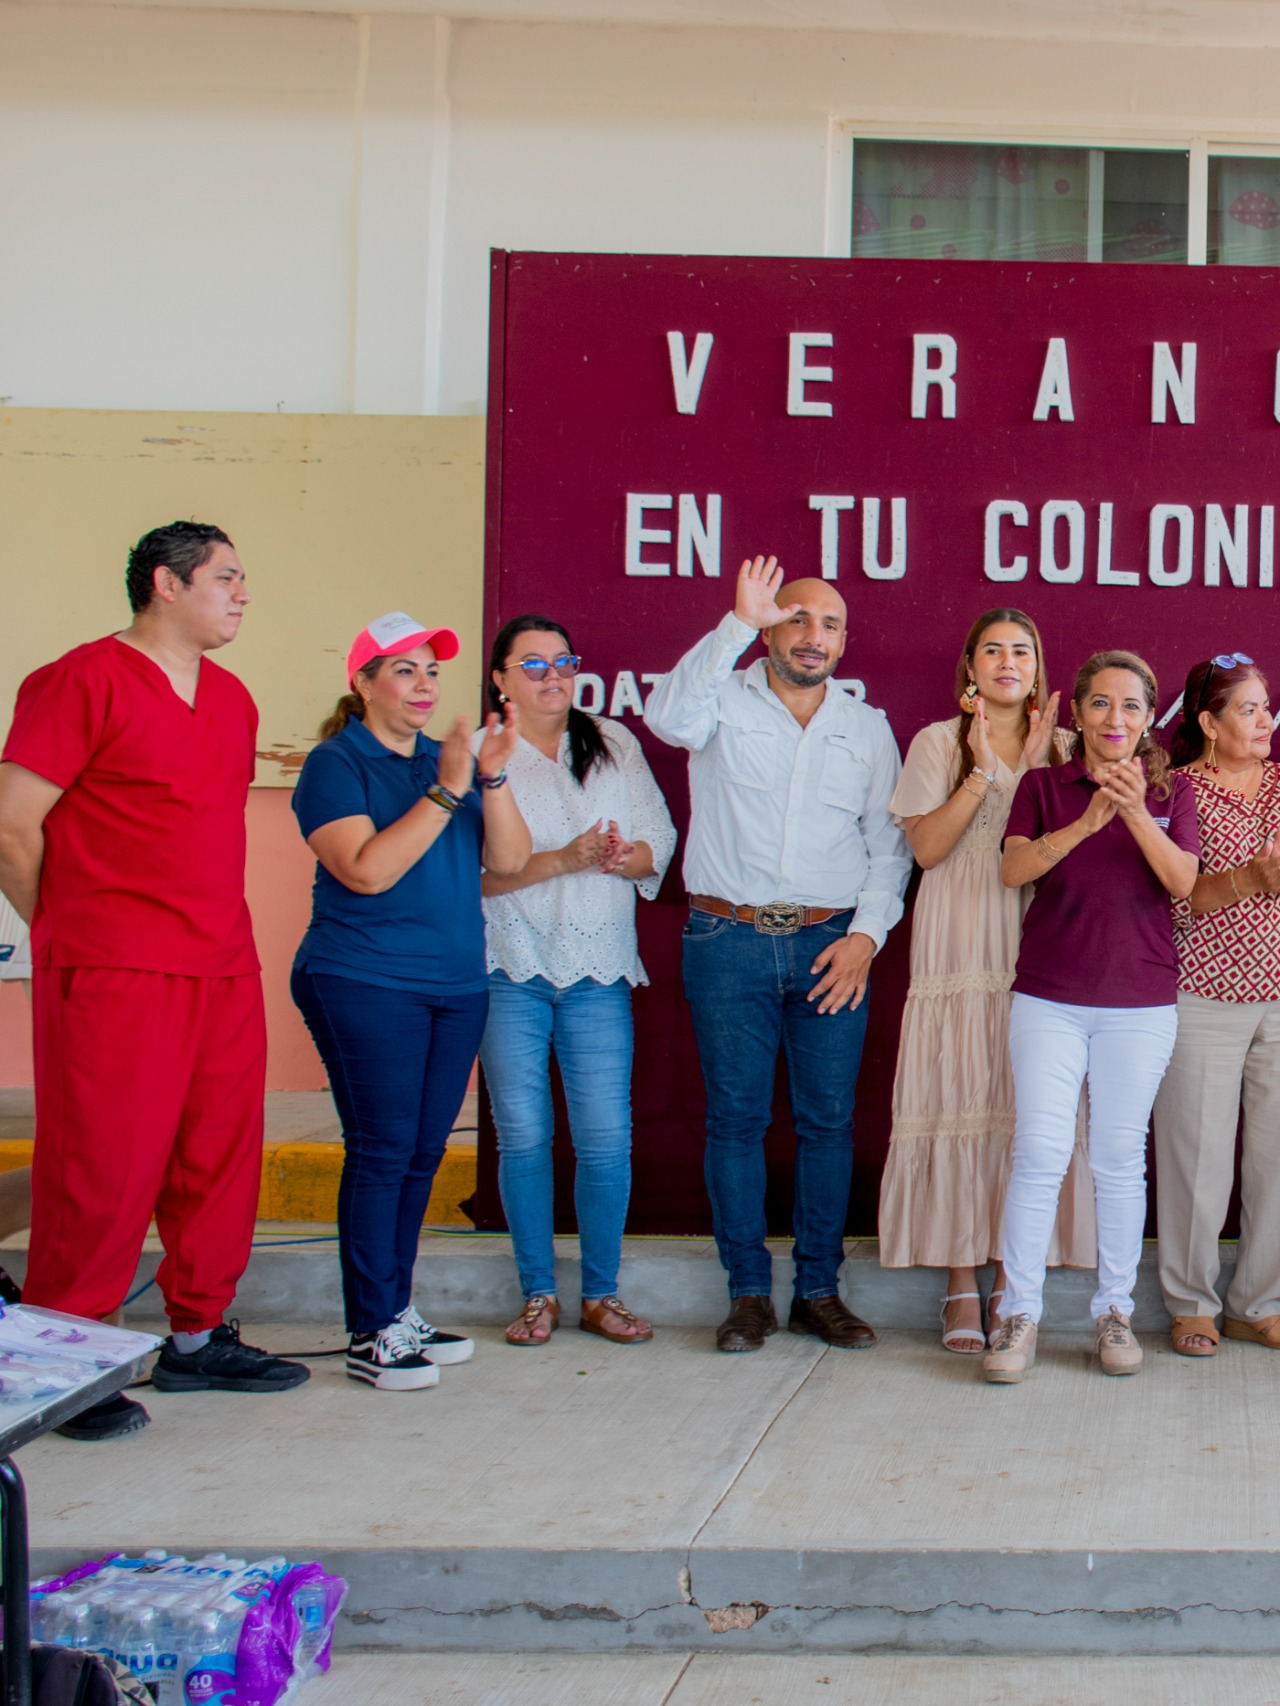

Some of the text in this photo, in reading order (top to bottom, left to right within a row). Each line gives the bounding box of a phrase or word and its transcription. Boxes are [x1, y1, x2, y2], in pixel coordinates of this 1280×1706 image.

[625, 492, 723, 578] EN
[808, 494, 907, 582] TU
[189, 1674, 213, 1689] 40
